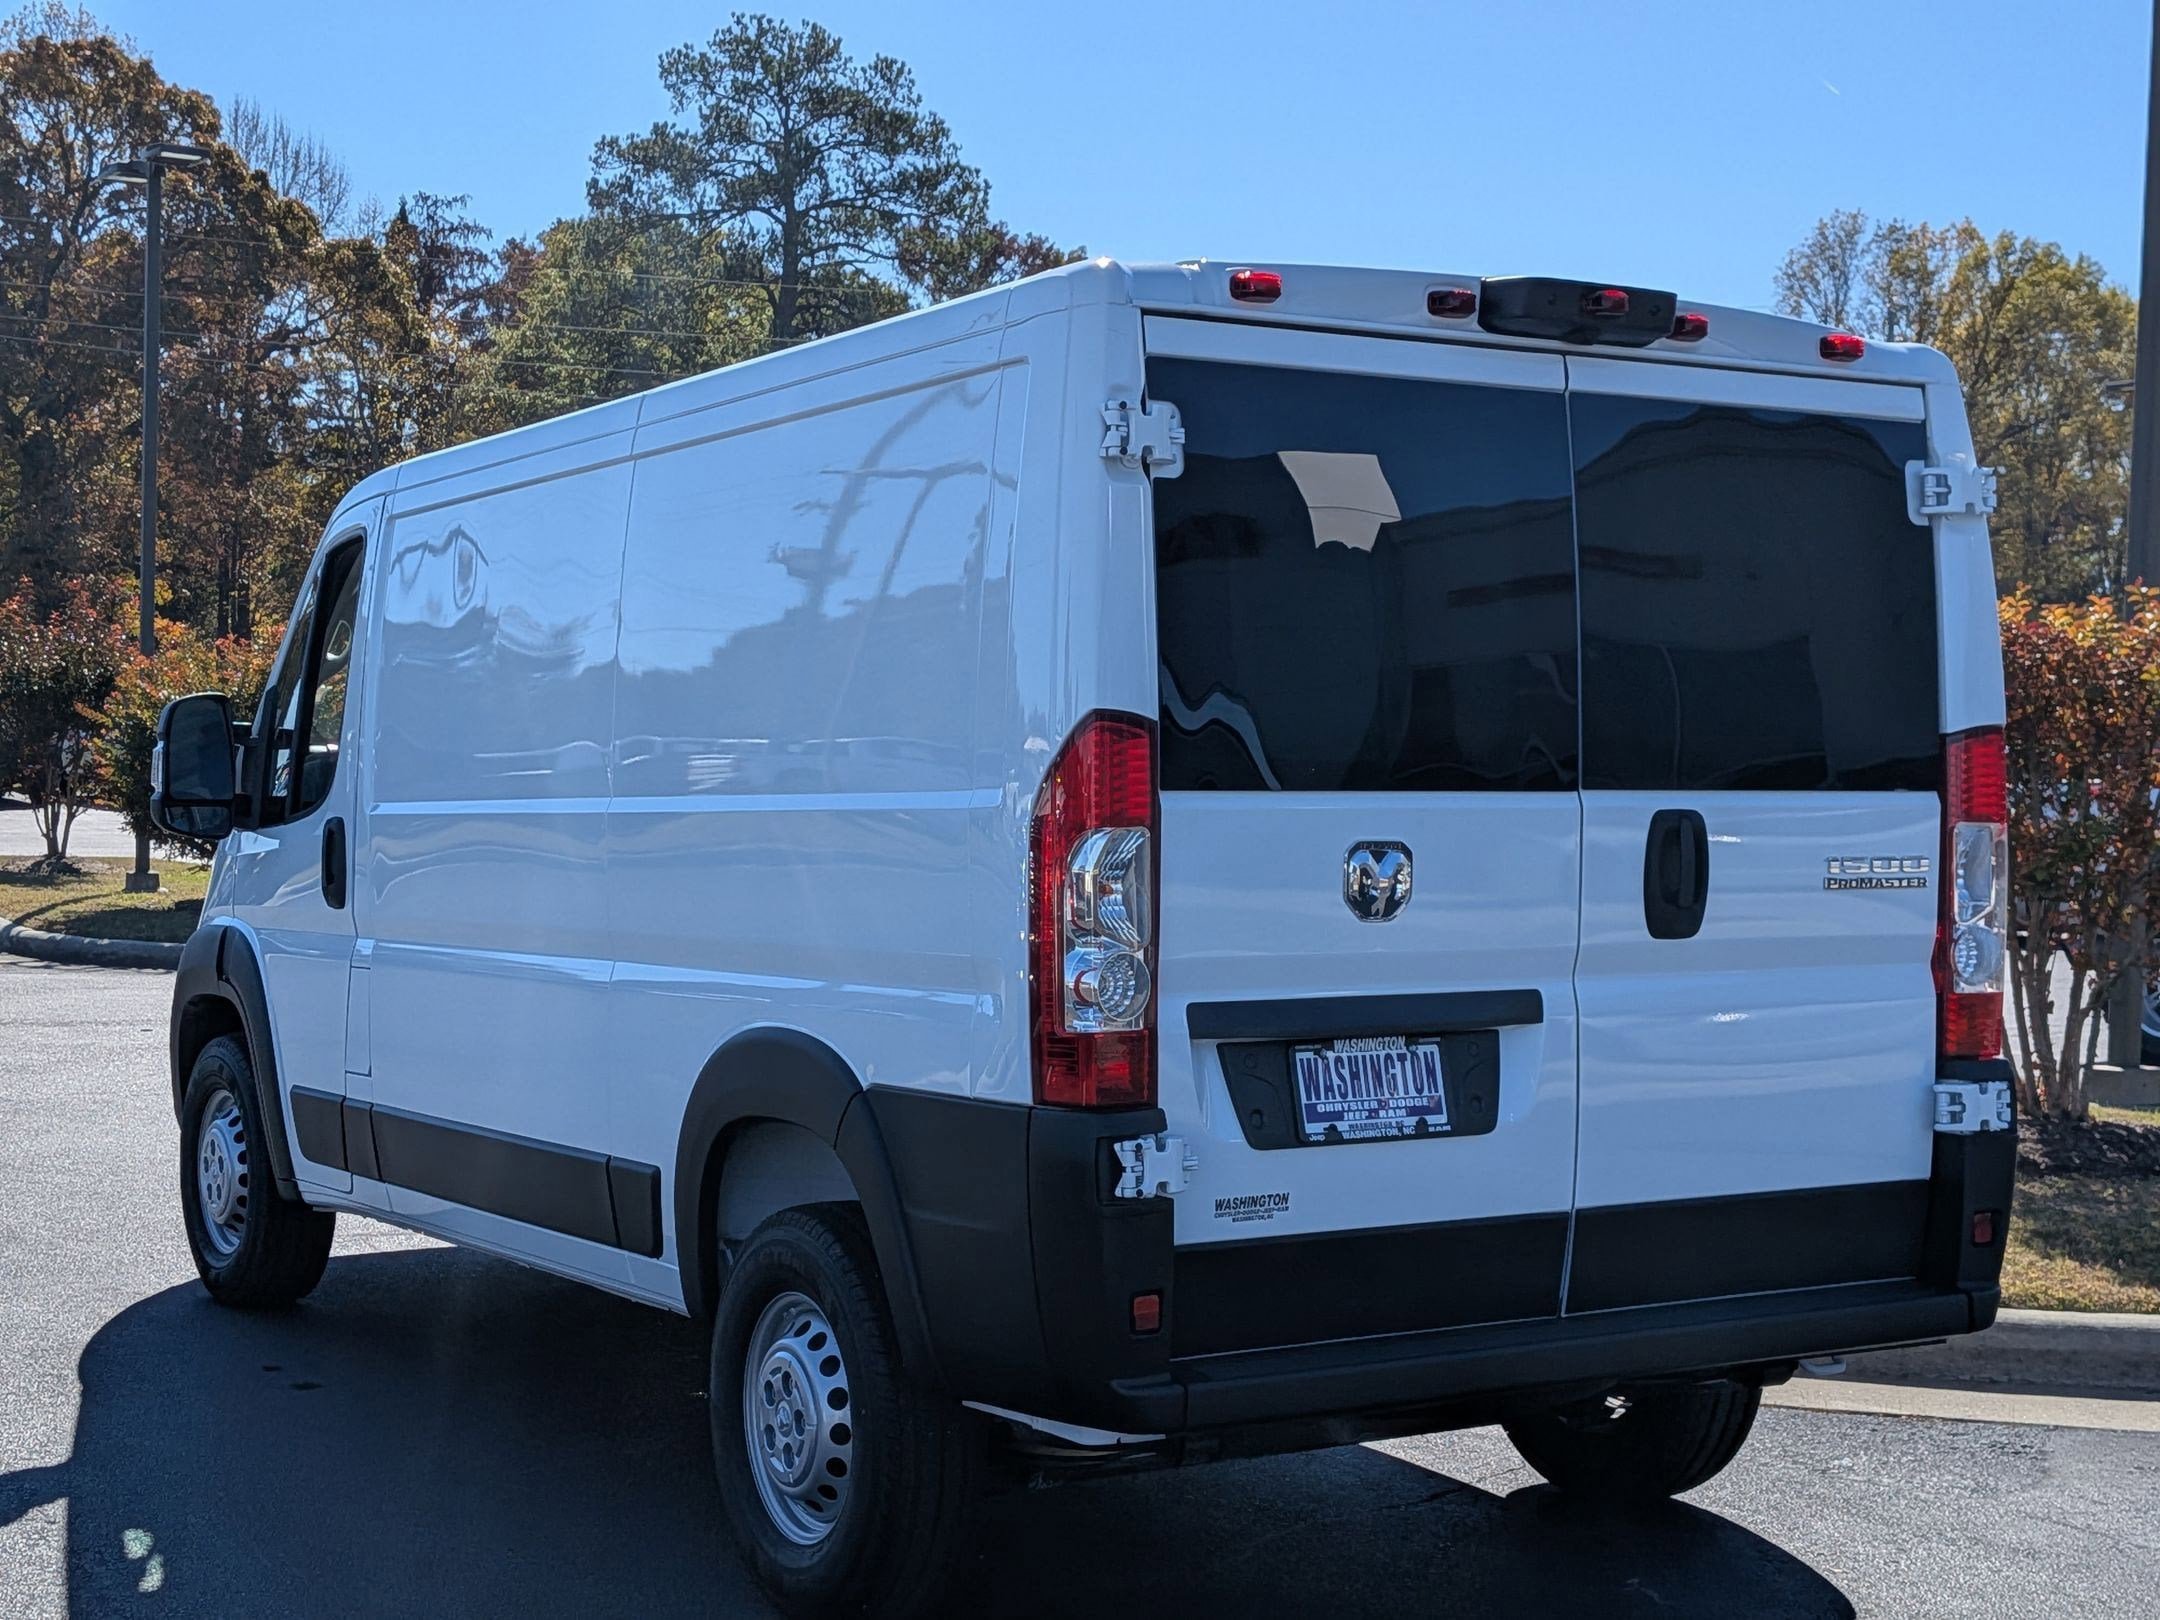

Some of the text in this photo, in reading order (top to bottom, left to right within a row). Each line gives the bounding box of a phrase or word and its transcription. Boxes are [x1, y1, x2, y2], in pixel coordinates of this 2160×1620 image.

[1825, 856, 1930, 874] 1500
[1333, 1035, 1407, 1053] WASHINGTON
[1299, 1051, 1439, 1101] WASHINGTON
[1317, 1096, 1430, 1113] CHRYSLER DODGE
[1343, 1107, 1407, 1121] JEEP RAM
[1342, 1128, 1402, 1140] WASHINGTON,
[1403, 1125, 1416, 1136] NC
[1215, 1192, 1289, 1212] WASHINGTON
